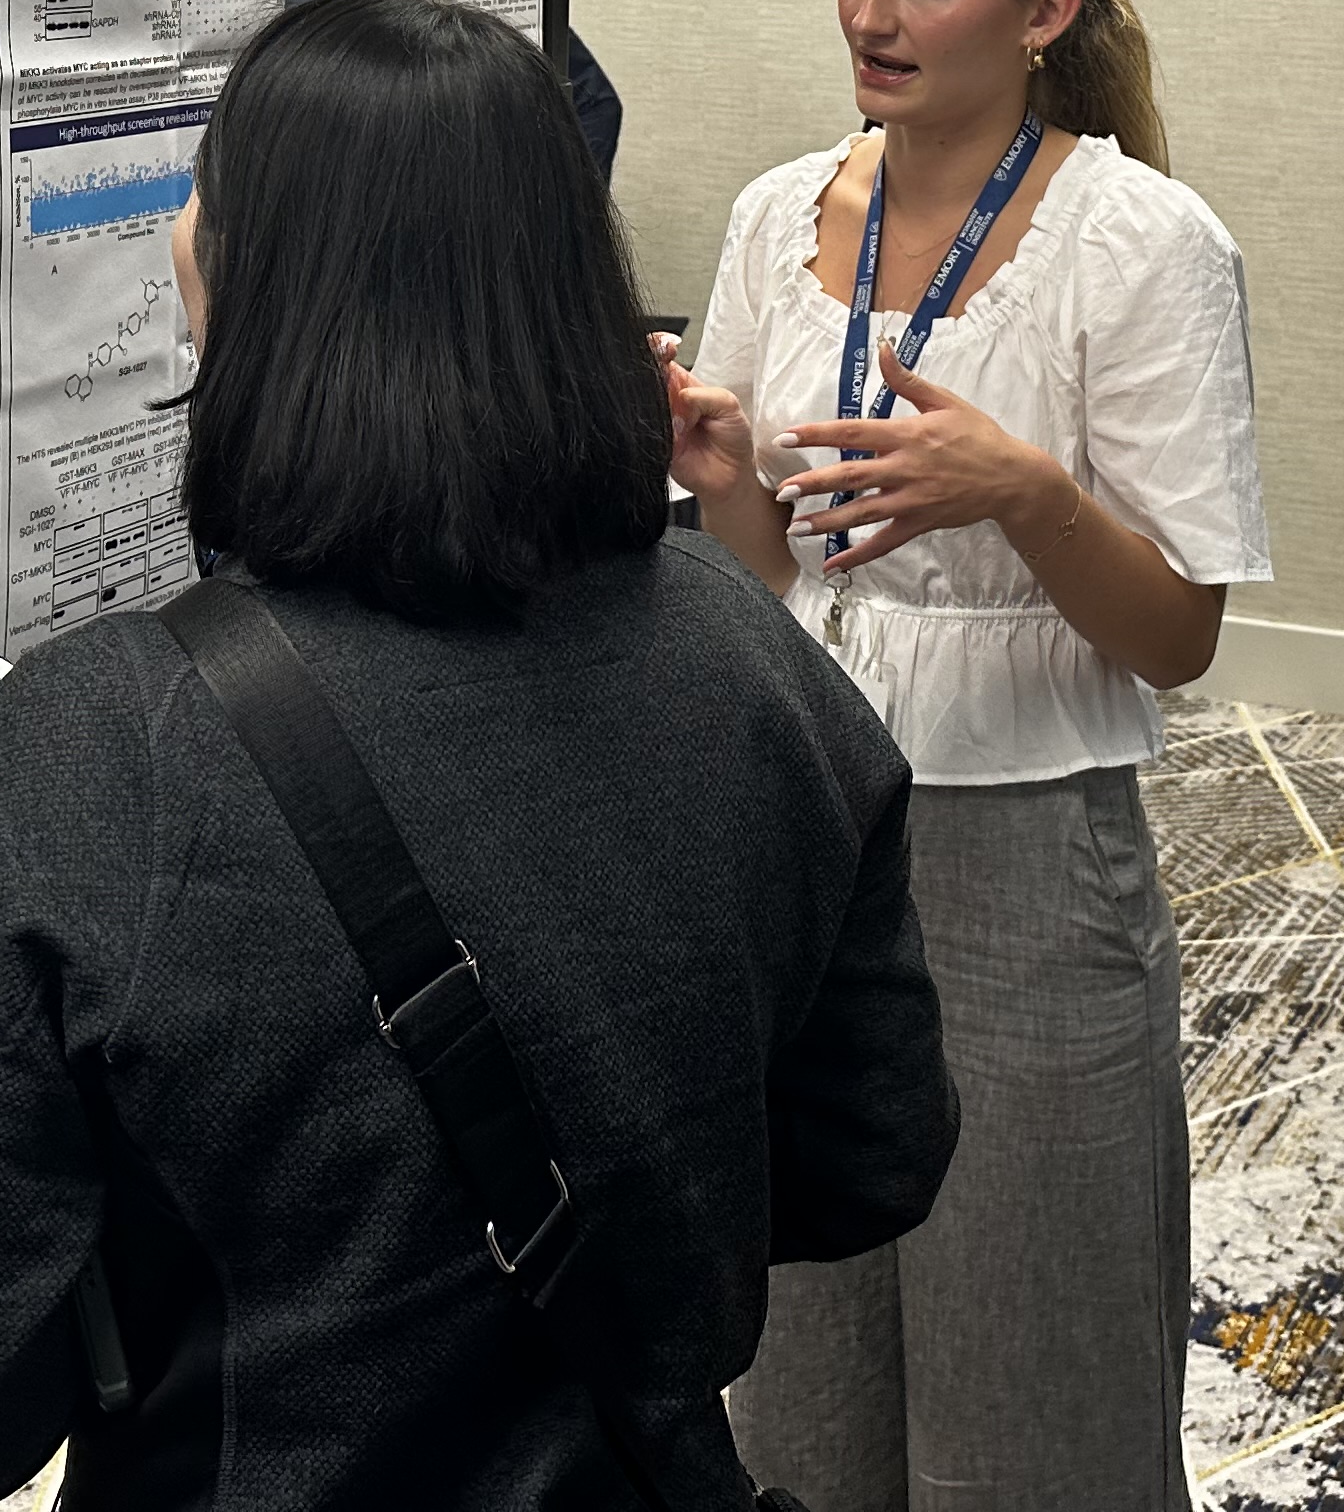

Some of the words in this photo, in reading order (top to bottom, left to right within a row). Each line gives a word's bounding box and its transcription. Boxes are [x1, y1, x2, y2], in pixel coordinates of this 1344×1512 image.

[1000, 130, 1028, 171] EMORY
[965, 215, 984, 243] CANCER
[867, 234, 878, 274] EMORY
[934, 245, 961, 288] EMORY
[851, 361, 865, 403] EMORY
[873, 381, 889, 410] EMO
